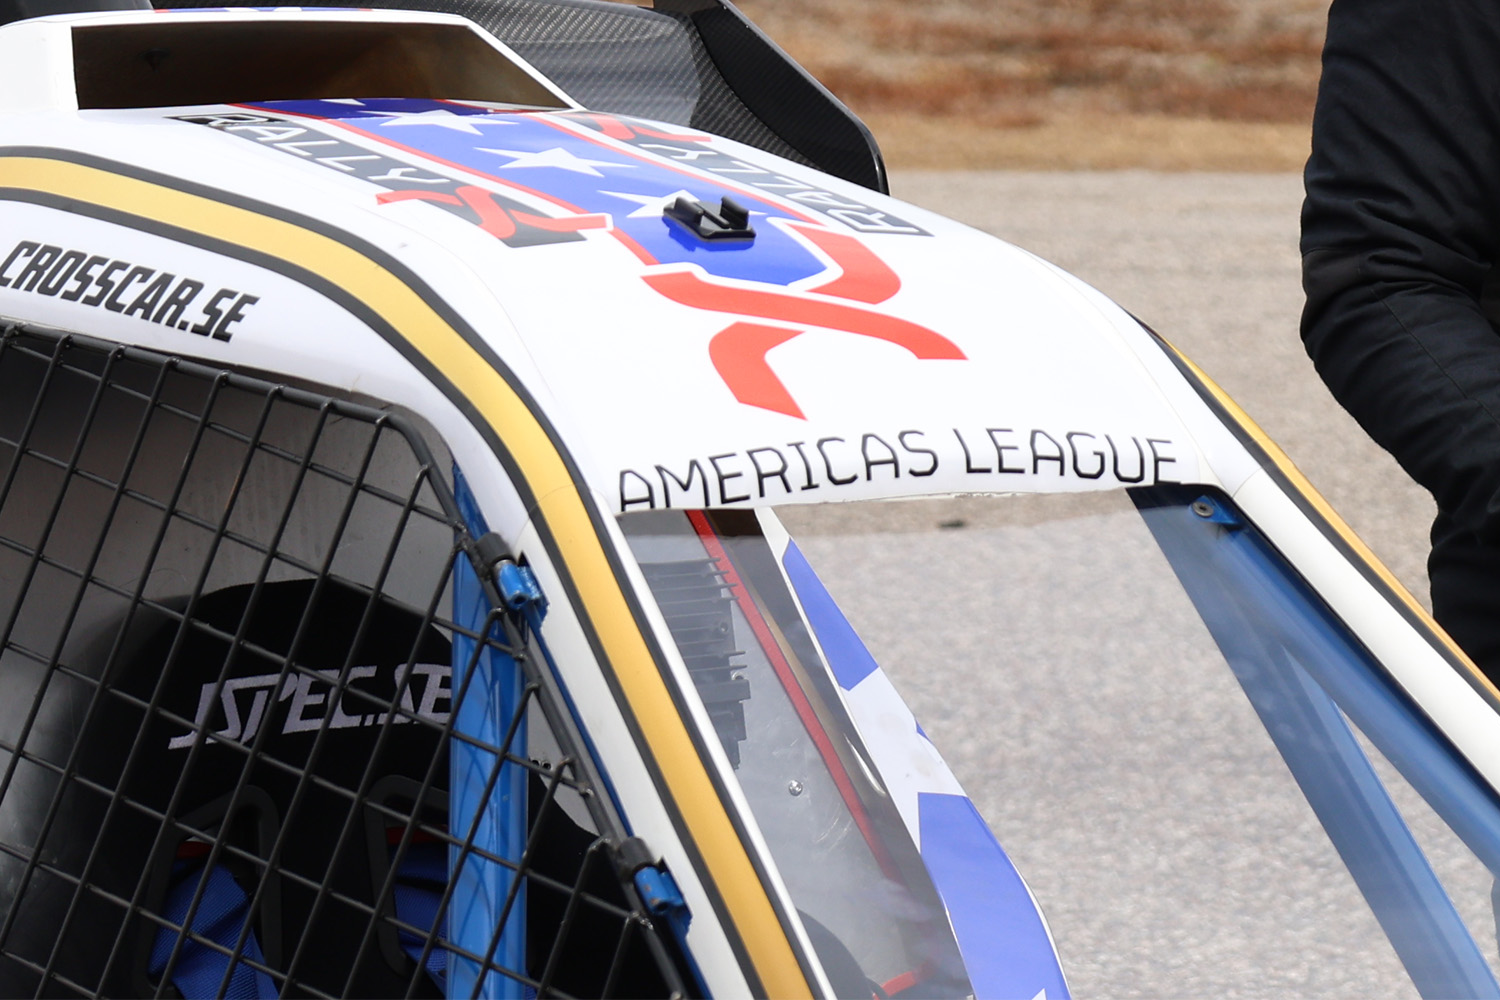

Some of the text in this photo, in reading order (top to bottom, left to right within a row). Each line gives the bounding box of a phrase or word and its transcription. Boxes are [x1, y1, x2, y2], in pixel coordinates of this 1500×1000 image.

[0, 239, 261, 343] CROSSCAR.SE
[618, 427, 1181, 512] AMERICAS LEAGUE
